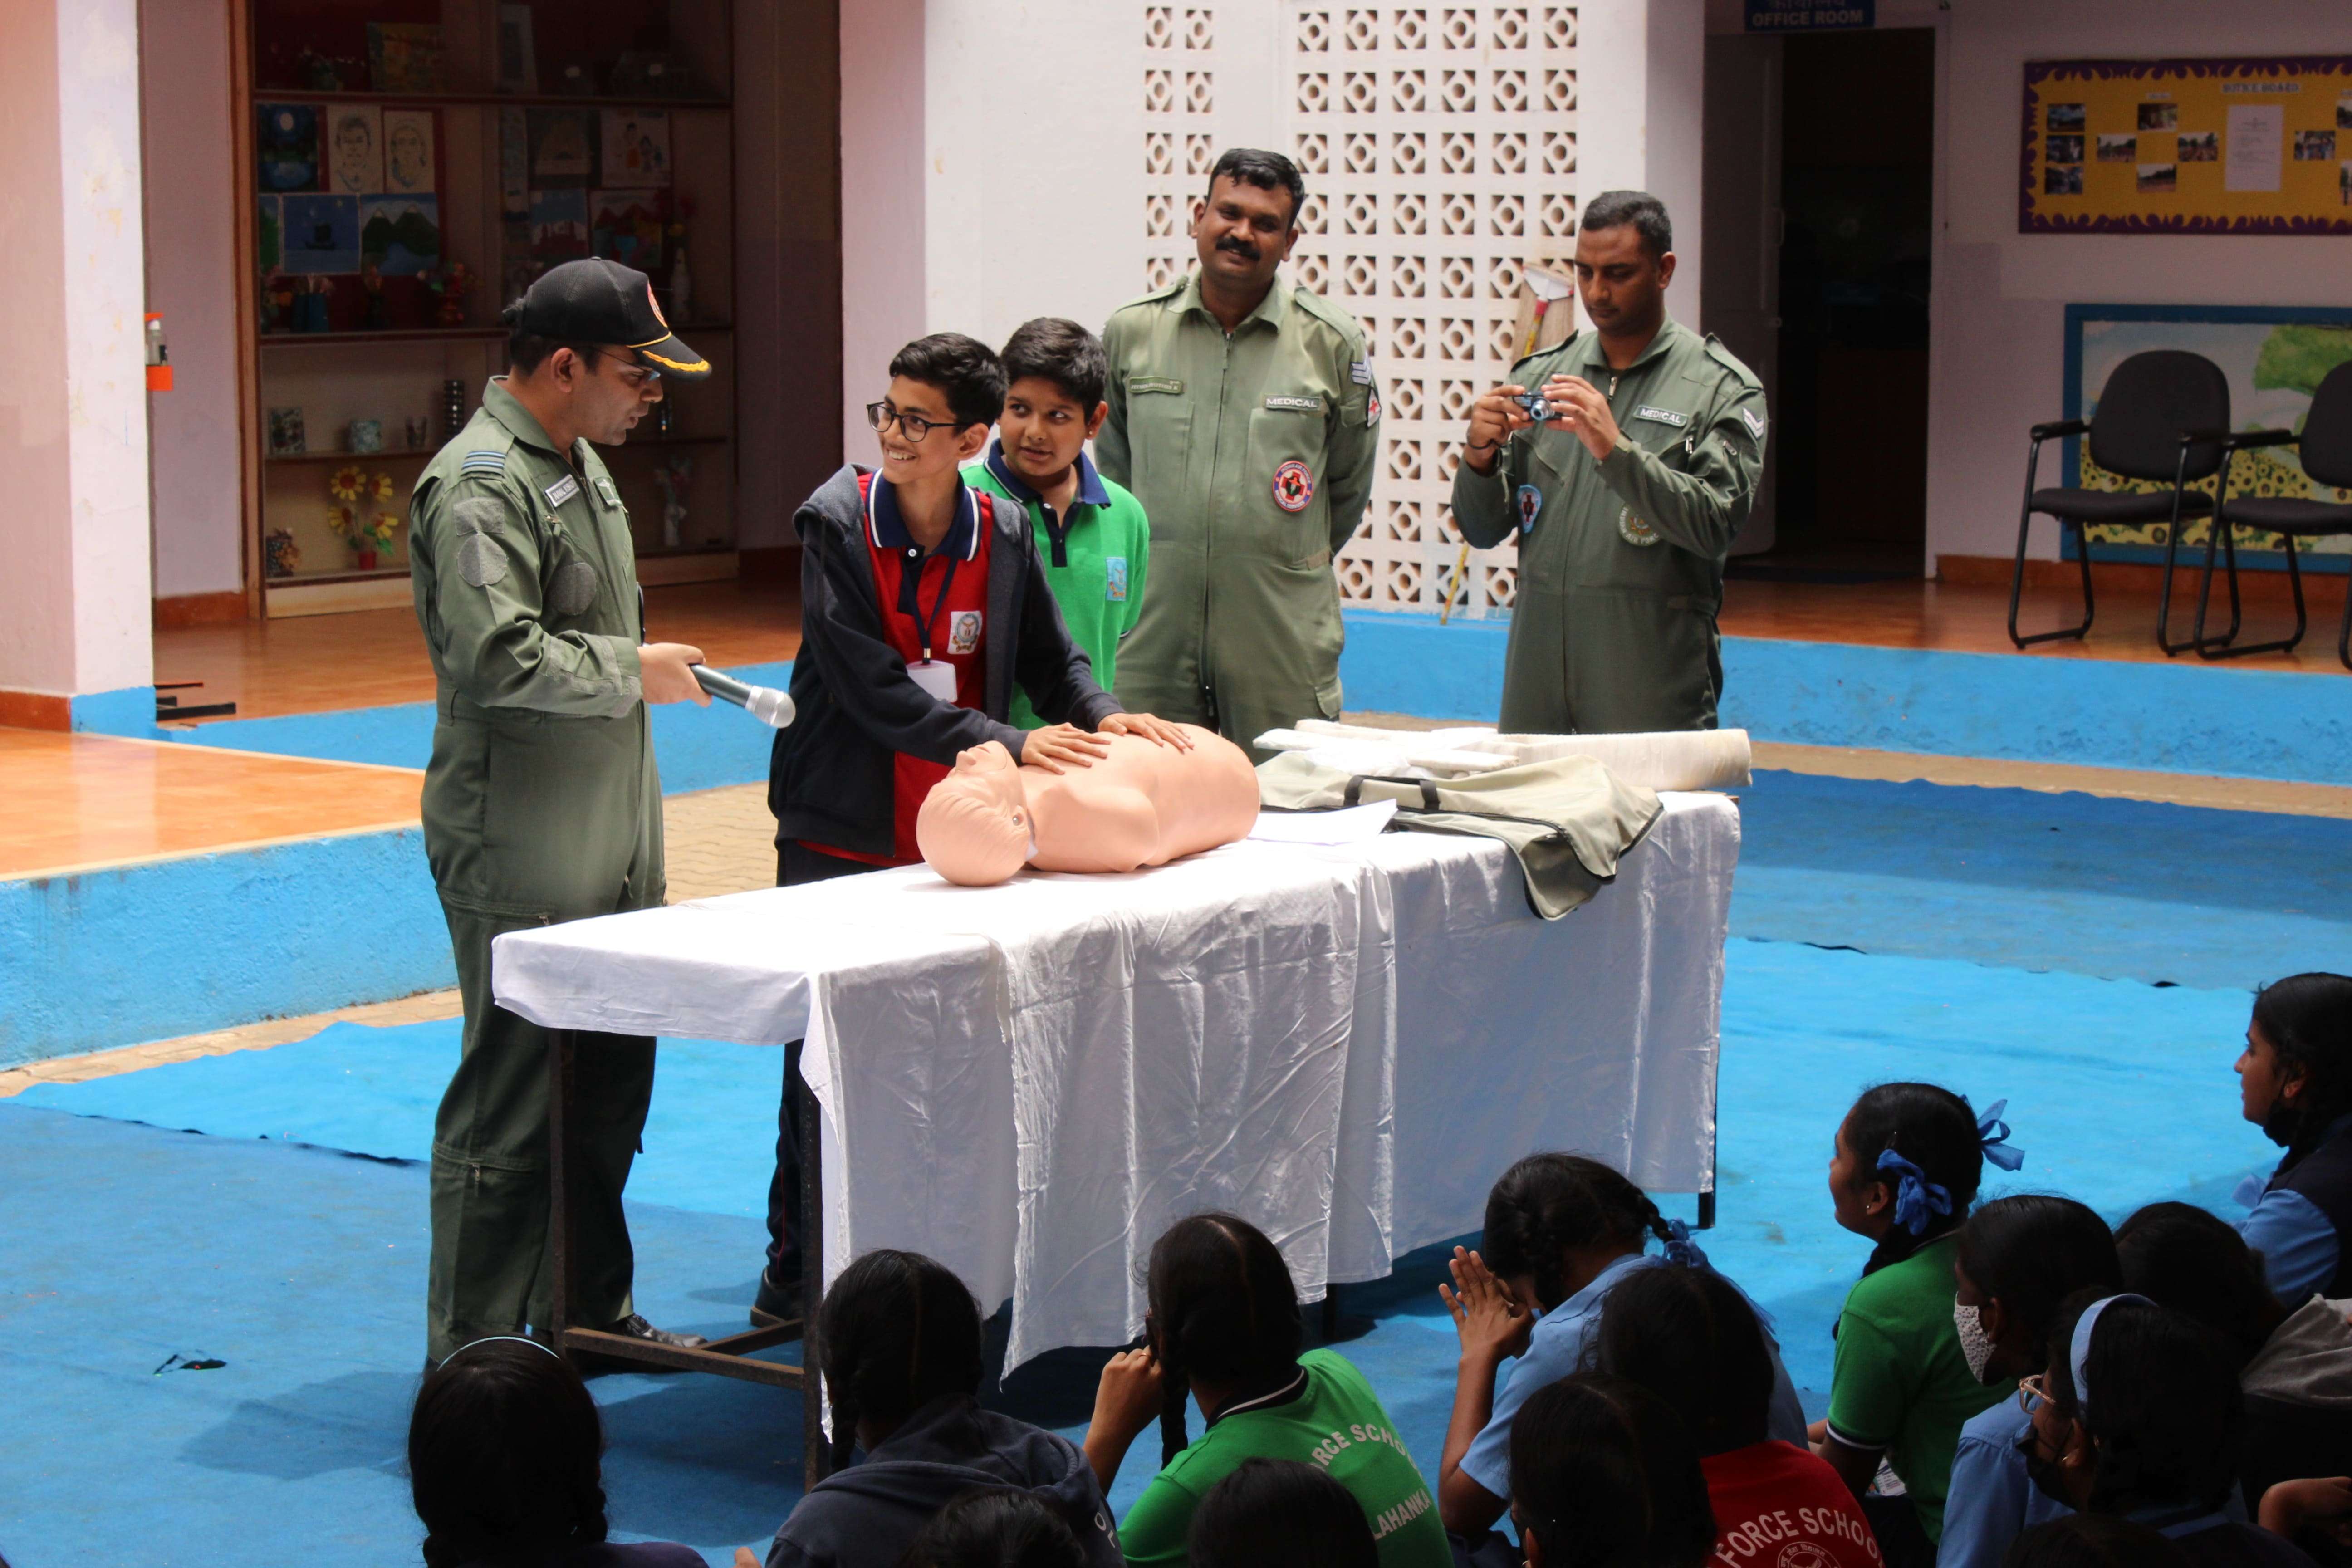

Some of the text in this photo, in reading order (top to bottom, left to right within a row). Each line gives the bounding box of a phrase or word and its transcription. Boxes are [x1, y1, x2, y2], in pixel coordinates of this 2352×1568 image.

[1752, 9, 1863, 27] OFFICE ROOM
[1266, 398, 1318, 408] MEDICAL
[1640, 408, 1681, 423] MEDICAL
[1626, 533, 1639, 544] AIR
[1640, 532, 1659, 544] FORC
[1715, 1510, 1799, 1568] FORCE
